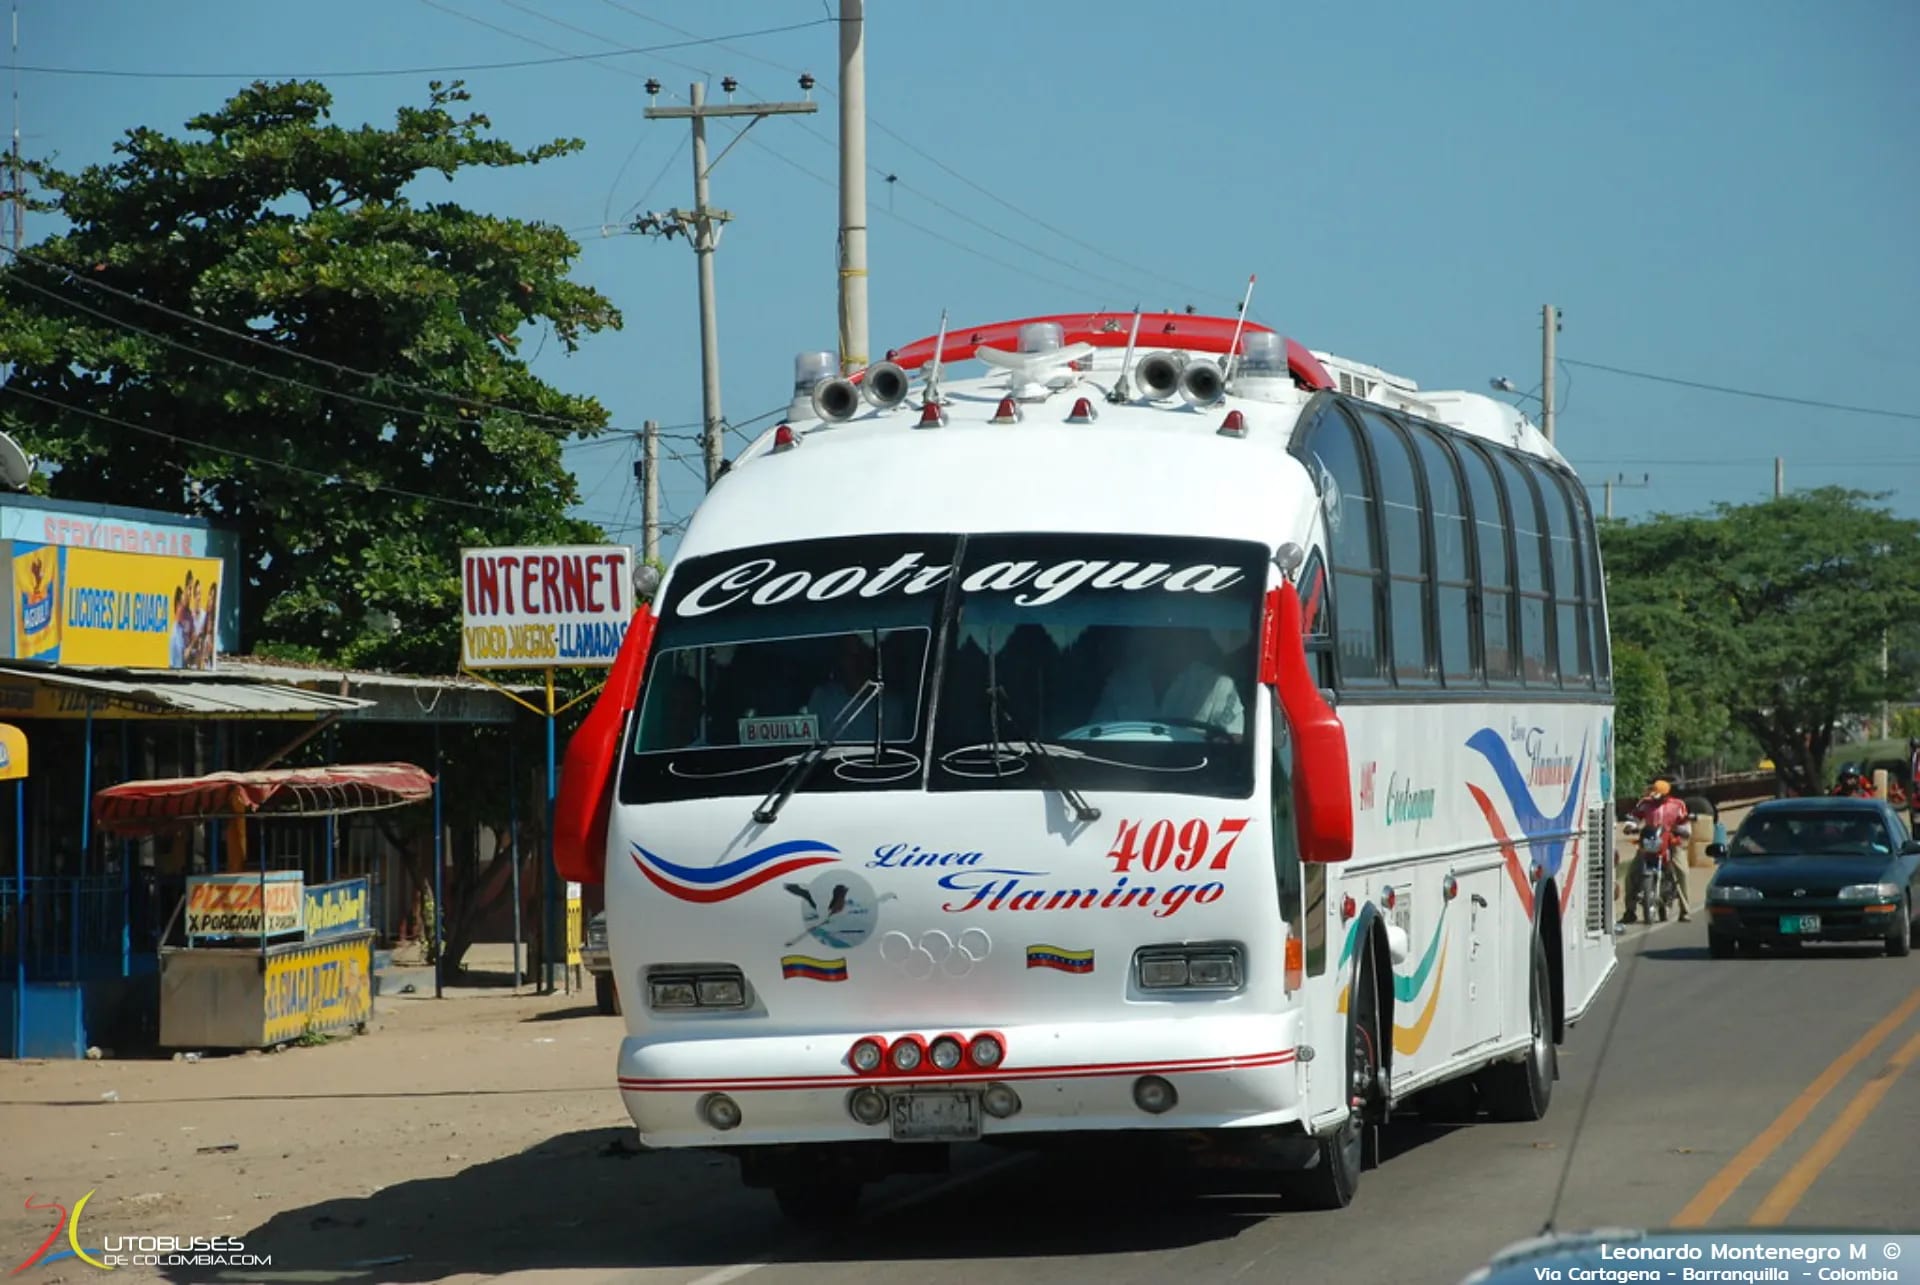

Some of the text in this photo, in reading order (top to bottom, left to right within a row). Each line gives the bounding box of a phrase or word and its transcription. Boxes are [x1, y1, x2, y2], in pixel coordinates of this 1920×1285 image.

[466, 554, 625, 616] INTERNET
[68, 588, 168, 633] LICORES LA GUACA
[465, 624, 507, 659] VIDEO
[508, 622, 556, 659] JUEGOS
[1106, 816, 1252, 874] 4097
[190, 884, 262, 912] PIZZA
[938, 868, 1225, 918] Flamingo
[189, 909, 260, 932] X PORCIÓN
